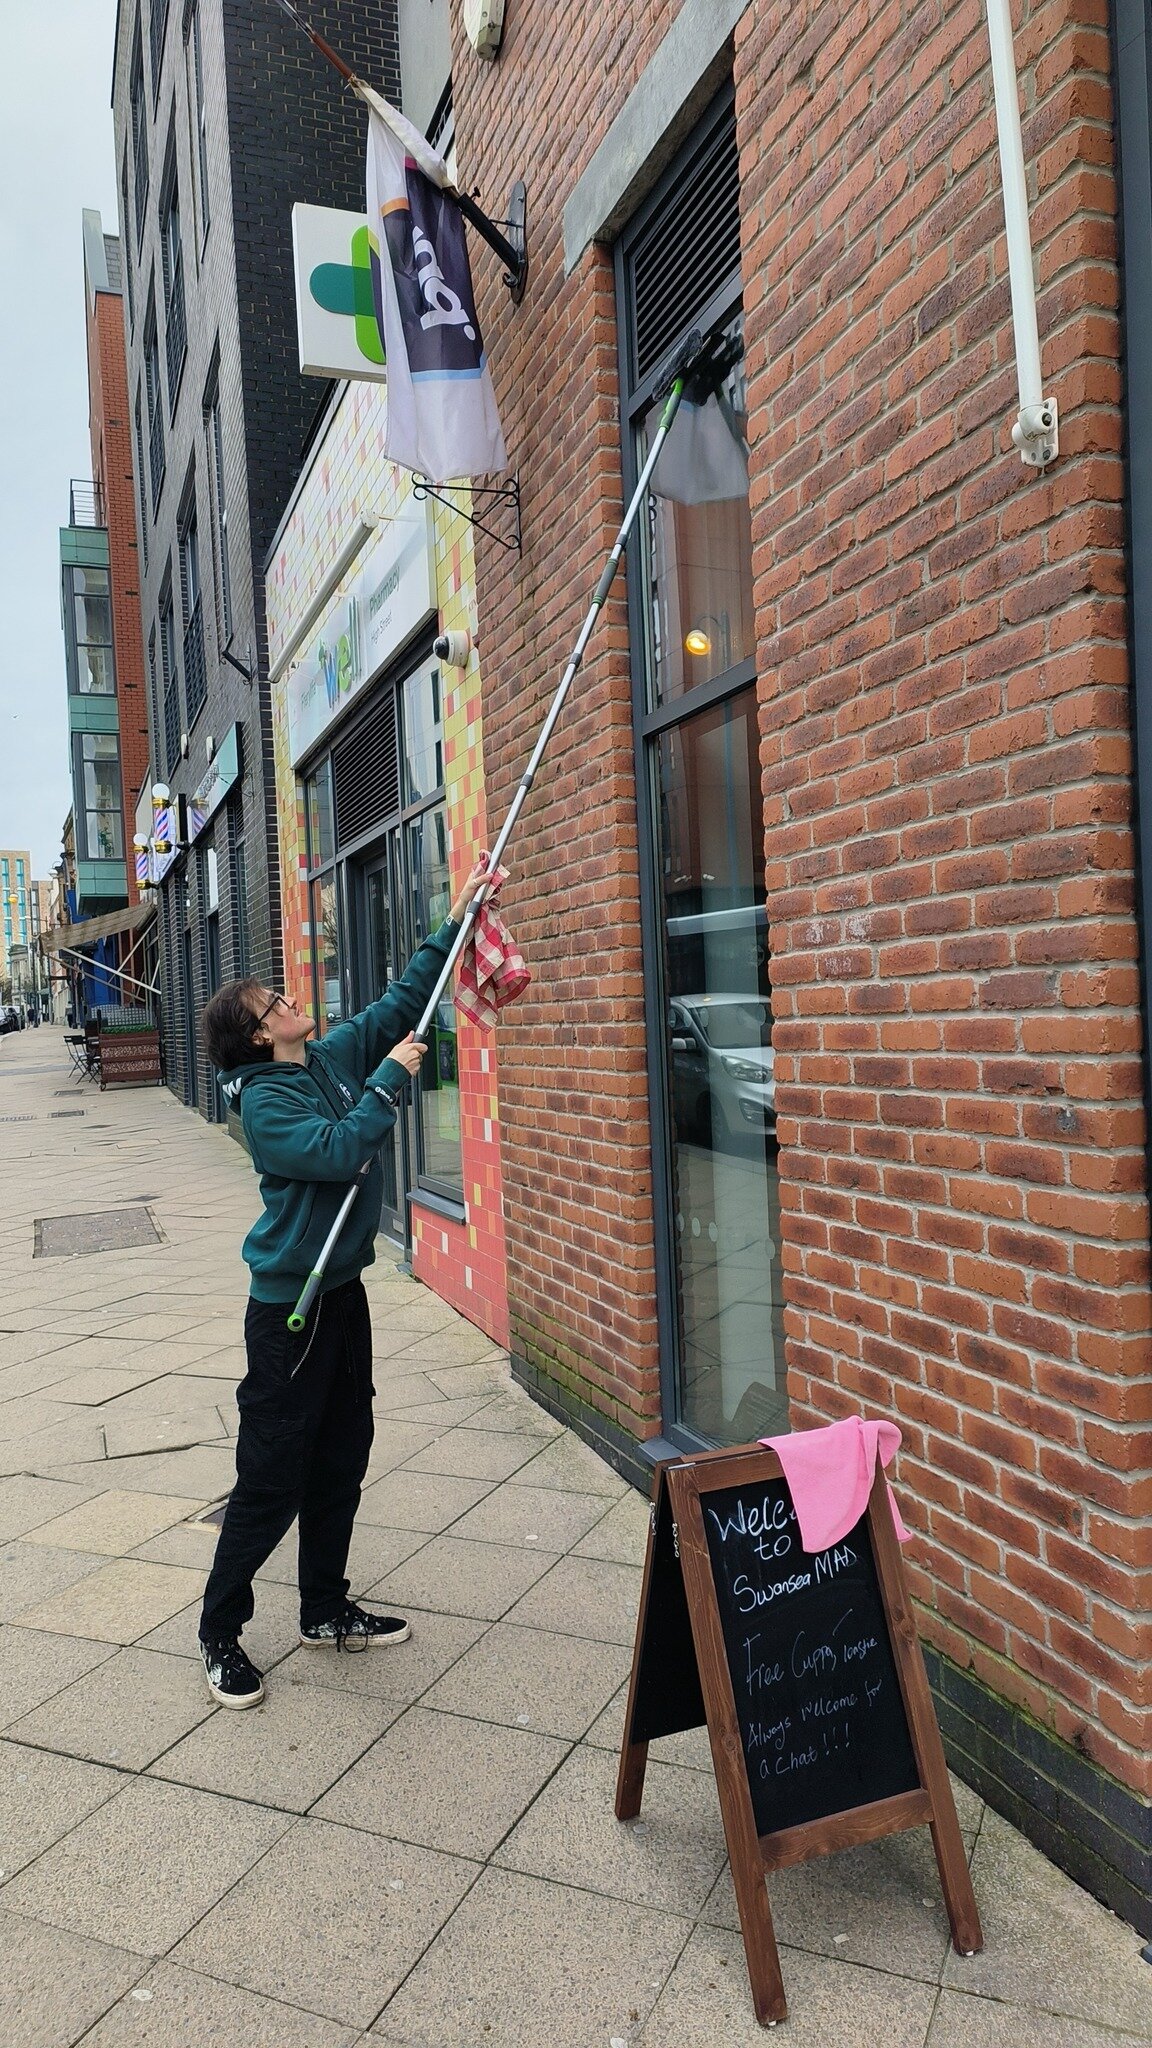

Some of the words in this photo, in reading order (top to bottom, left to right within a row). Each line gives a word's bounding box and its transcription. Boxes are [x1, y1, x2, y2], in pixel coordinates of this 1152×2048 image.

[369, 565, 400, 621] Pharmacy
[323, 596, 361, 711] well
[707, 1496, 796, 1542] Welc
[754, 1535, 792, 1560] to
[733, 1573, 812, 1612] Swansea
[814, 1544, 858, 1584] MAD
[742, 1633, 784, 1696] Free
[747, 1716, 792, 1753] Always
[801, 1693, 858, 1722] welcome
[864, 1679, 882, 1707] for
[759, 1758, 770, 1779] a
